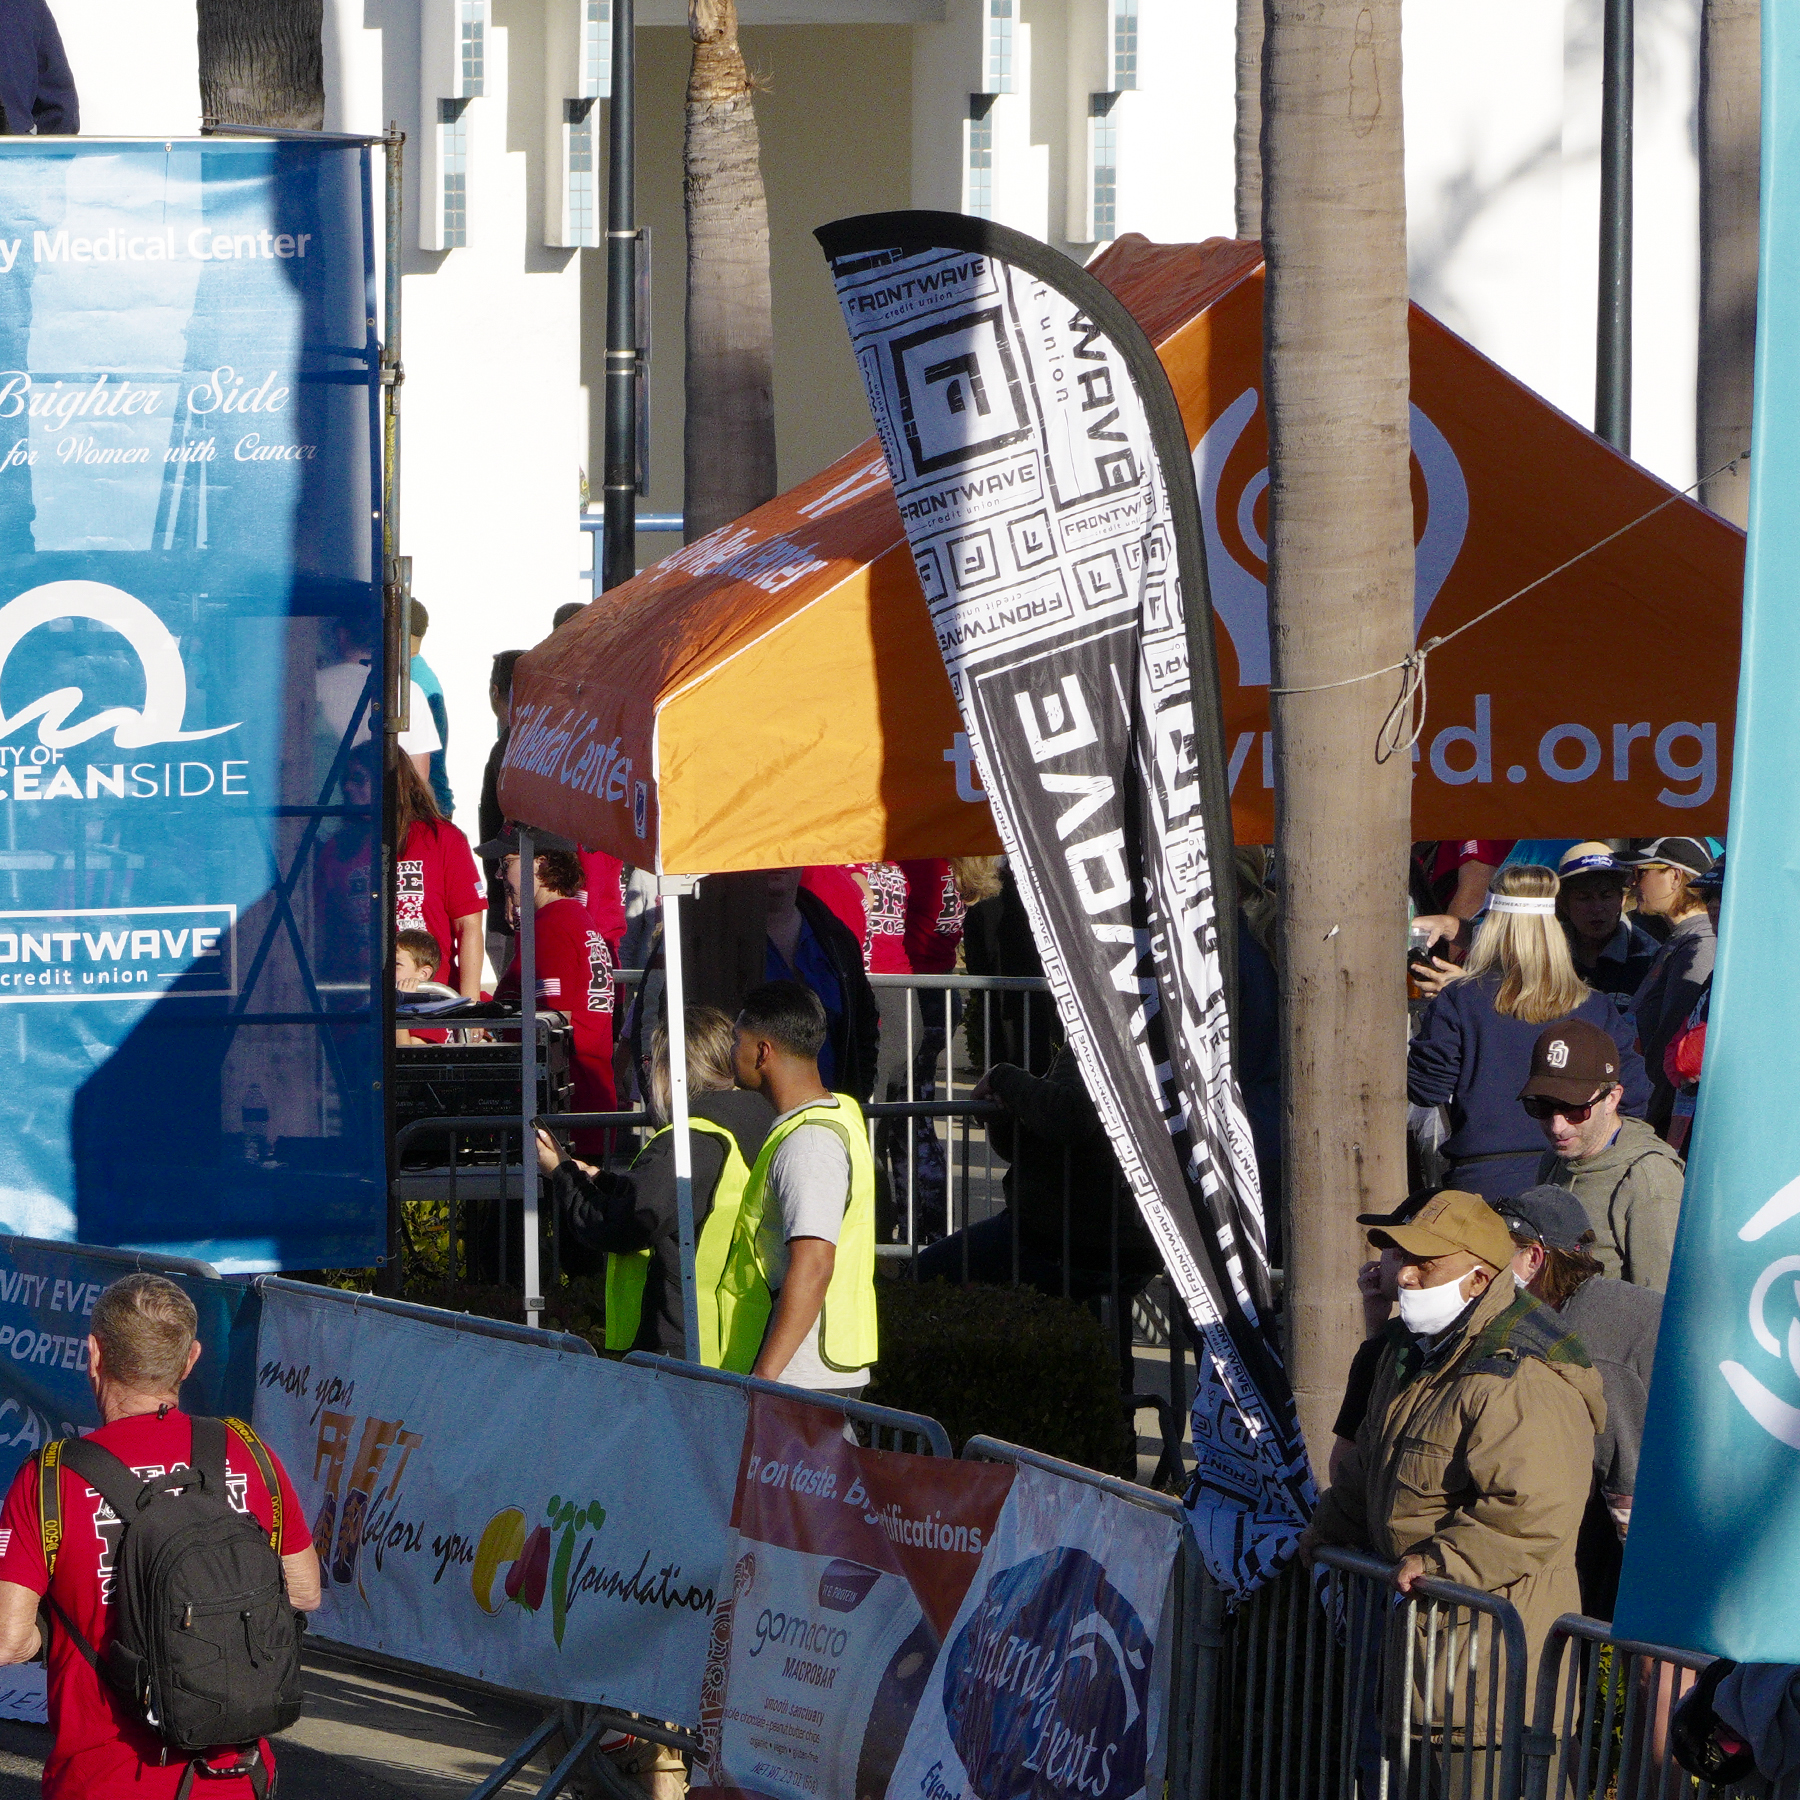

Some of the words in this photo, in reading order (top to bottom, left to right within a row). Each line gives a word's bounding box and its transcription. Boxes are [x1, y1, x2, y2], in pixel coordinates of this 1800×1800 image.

[32, 228, 179, 263] Medical
[189, 226, 312, 261] Center
[847, 257, 986, 317] FRONTWAVE
[883, 301, 915, 320] credit
[918, 290, 954, 309] union
[187, 364, 289, 415] Side
[55, 435, 152, 468] Women
[162, 435, 218, 467] with
[232, 432, 318, 463] Cancer
[900, 463, 1036, 524] FRONTWAVE
[926, 508, 963, 530] credit
[966, 496, 1001, 516] union
[30, 746, 65, 766] OF
[0, 966, 76, 988] credit
[82, 965, 149, 987] union
[1546, 1040, 1570, 1070] SD
[226, 1416, 256, 1444] Nikon
[45, 1441, 60, 1468] Nikon
[761, 1462, 788, 1489] on
[791, 1462, 838, 1502] taste.
[361, 1484, 424, 1572] before
[433, 1533, 474, 1584] you
[565, 1549, 717, 1617] foundation
[755, 1607, 848, 1658] gomacro
[783, 1656, 834, 1690] MACROBAR
